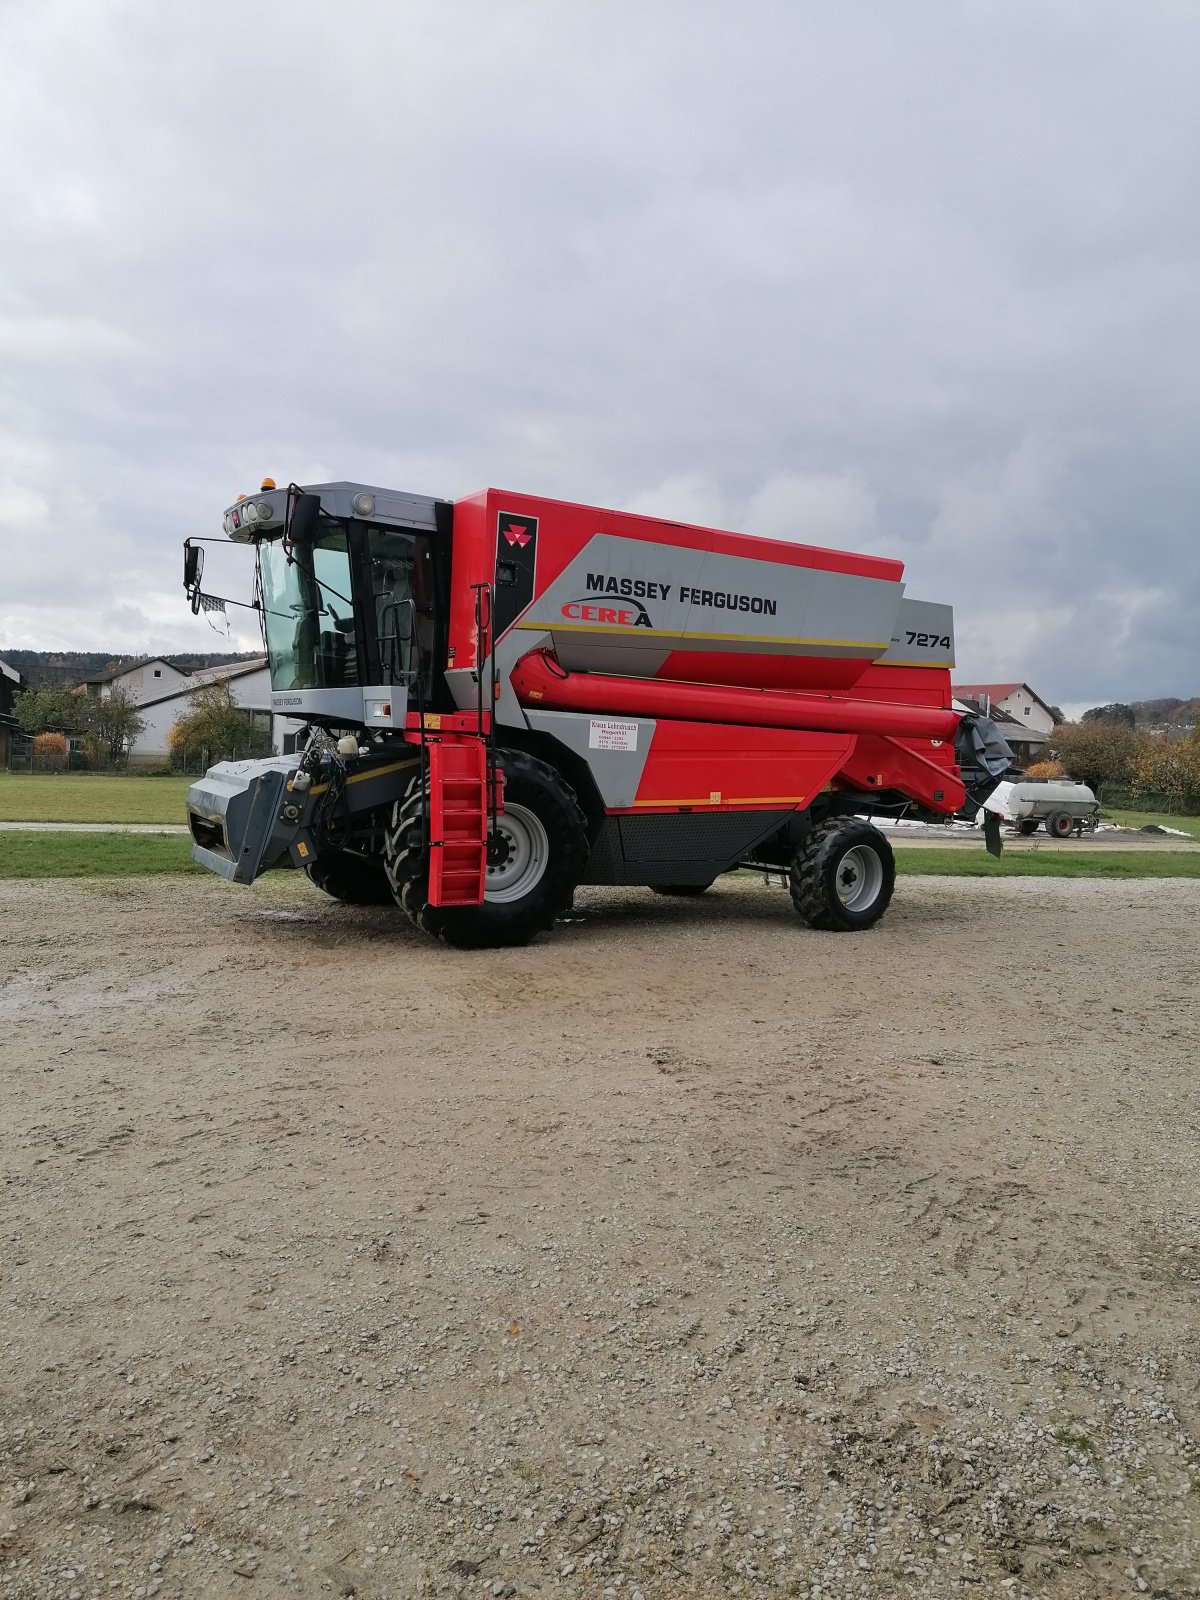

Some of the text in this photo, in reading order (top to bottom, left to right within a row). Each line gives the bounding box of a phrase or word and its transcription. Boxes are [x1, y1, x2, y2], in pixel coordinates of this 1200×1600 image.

[586, 573, 777, 616] MASSEY FERGUSON
[561, 602, 653, 628] CEREA
[905, 631, 951, 650] 7274
